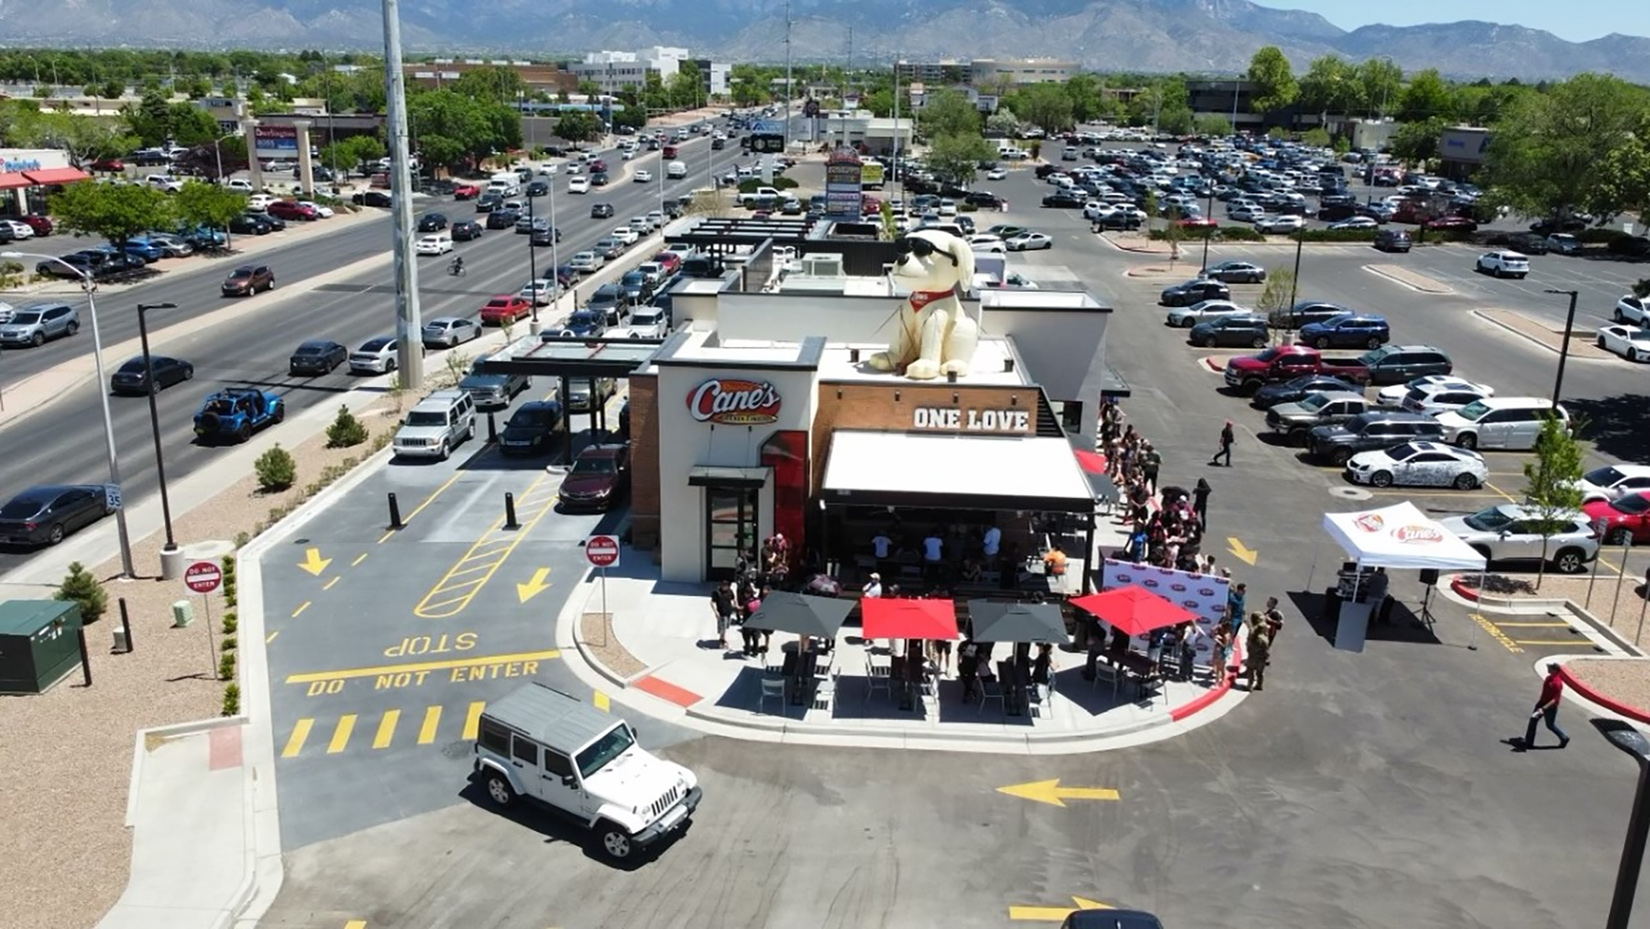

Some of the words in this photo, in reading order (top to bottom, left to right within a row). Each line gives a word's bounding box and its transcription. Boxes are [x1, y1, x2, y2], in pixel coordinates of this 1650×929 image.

[691, 379, 780, 421] Cane's
[914, 408, 961, 428] ONE
[967, 410, 1029, 430] LOVE
[108, 495, 121, 507] 35
[194, 581, 215, 589] ENTER
[384, 632, 479, 658] STOP
[306, 679, 346, 697] DO
[374, 670, 430, 690] NOT
[450, 660, 539, 683] ENTER
